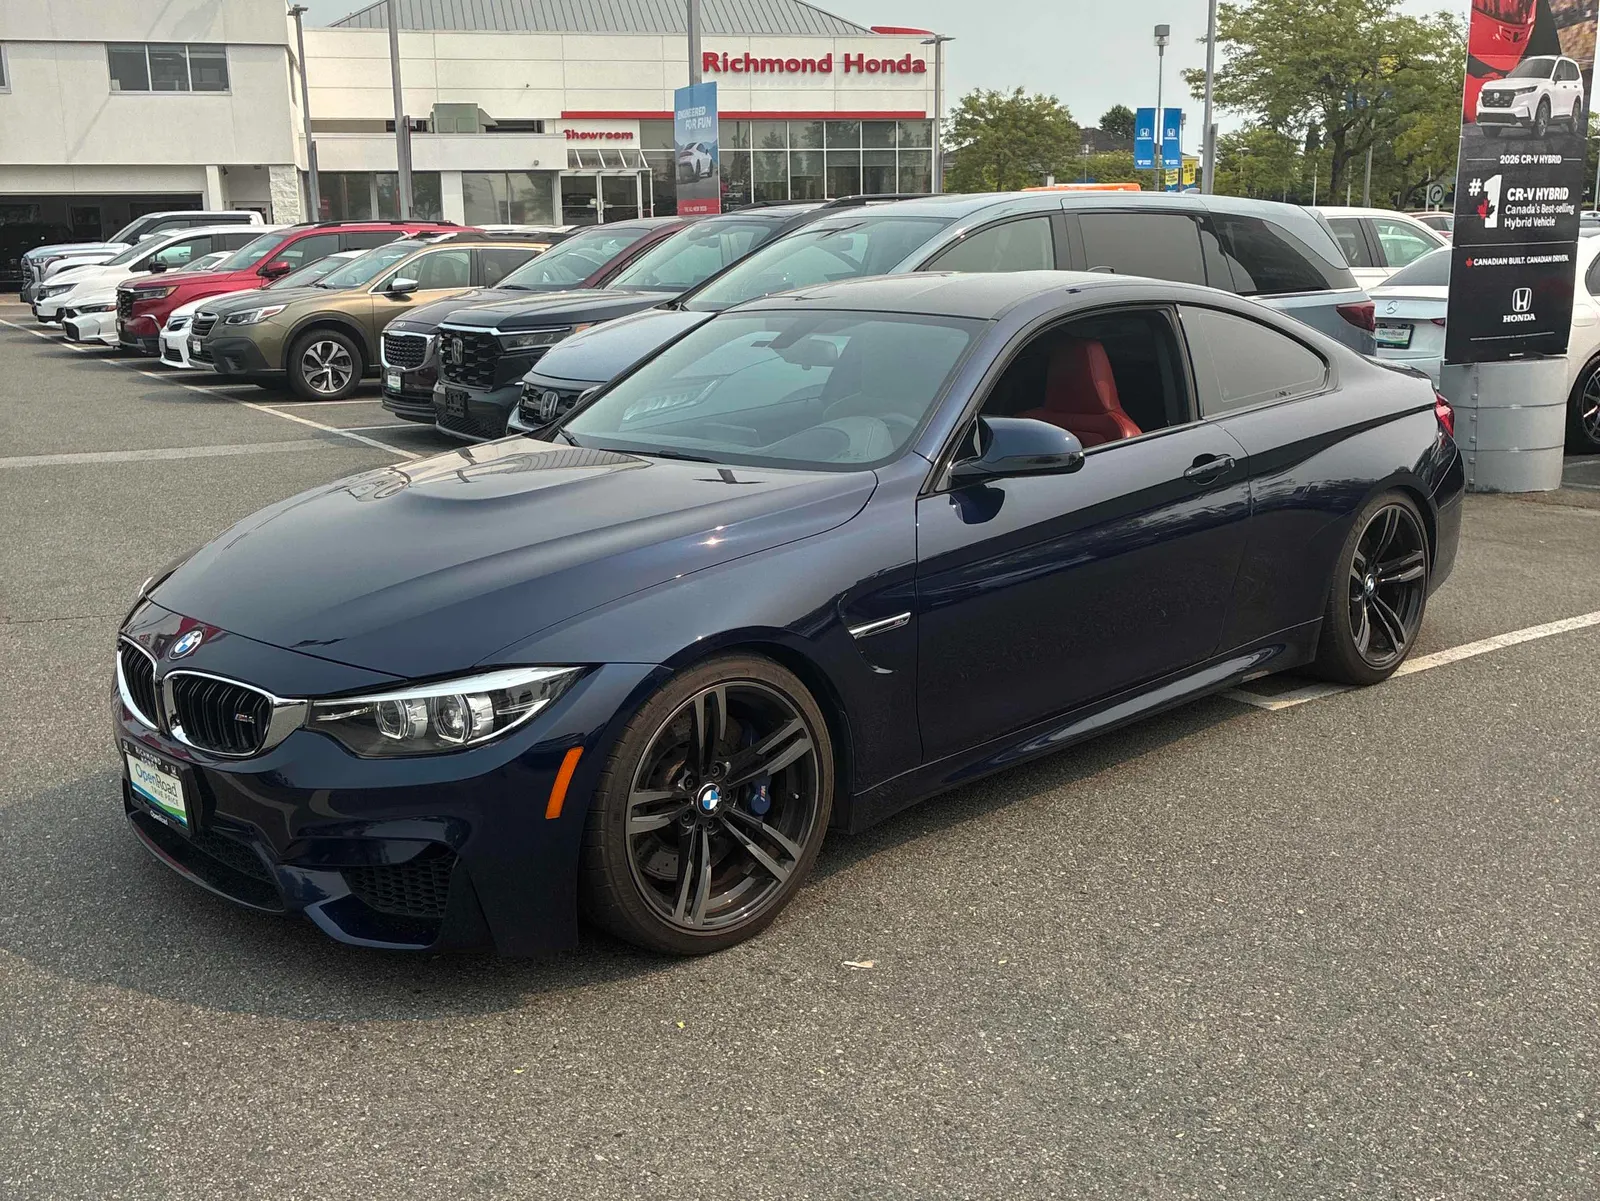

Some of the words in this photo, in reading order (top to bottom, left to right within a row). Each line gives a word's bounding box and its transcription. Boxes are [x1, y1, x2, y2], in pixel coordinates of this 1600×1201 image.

[702, 52, 832, 73] Richmond
[844, 53, 927, 74] Honda
[698, 116, 712, 129] FUN
[563, 129, 634, 140] Showroom
[1500, 155, 1520, 164] 2026
[1520, 155, 1539, 164] CR-V
[1540, 154, 1562, 164] HYBRID
[1507, 188, 1535, 201] CR-V
[1536, 187, 1569, 201] HYBRID
[1505, 203, 1540, 215] Canada's
[1541, 202, 1575, 215] Best-selling
[1504, 216, 1532, 230] Hybrid
[1473, 257, 1508, 266] CANADIAN
[1509, 256, 1526, 265] BUILT.
[1527, 255, 1553, 264] CANADIAN
[1502, 313, 1536, 323] HONDA
[135, 763, 178, 798] OpenRoad
